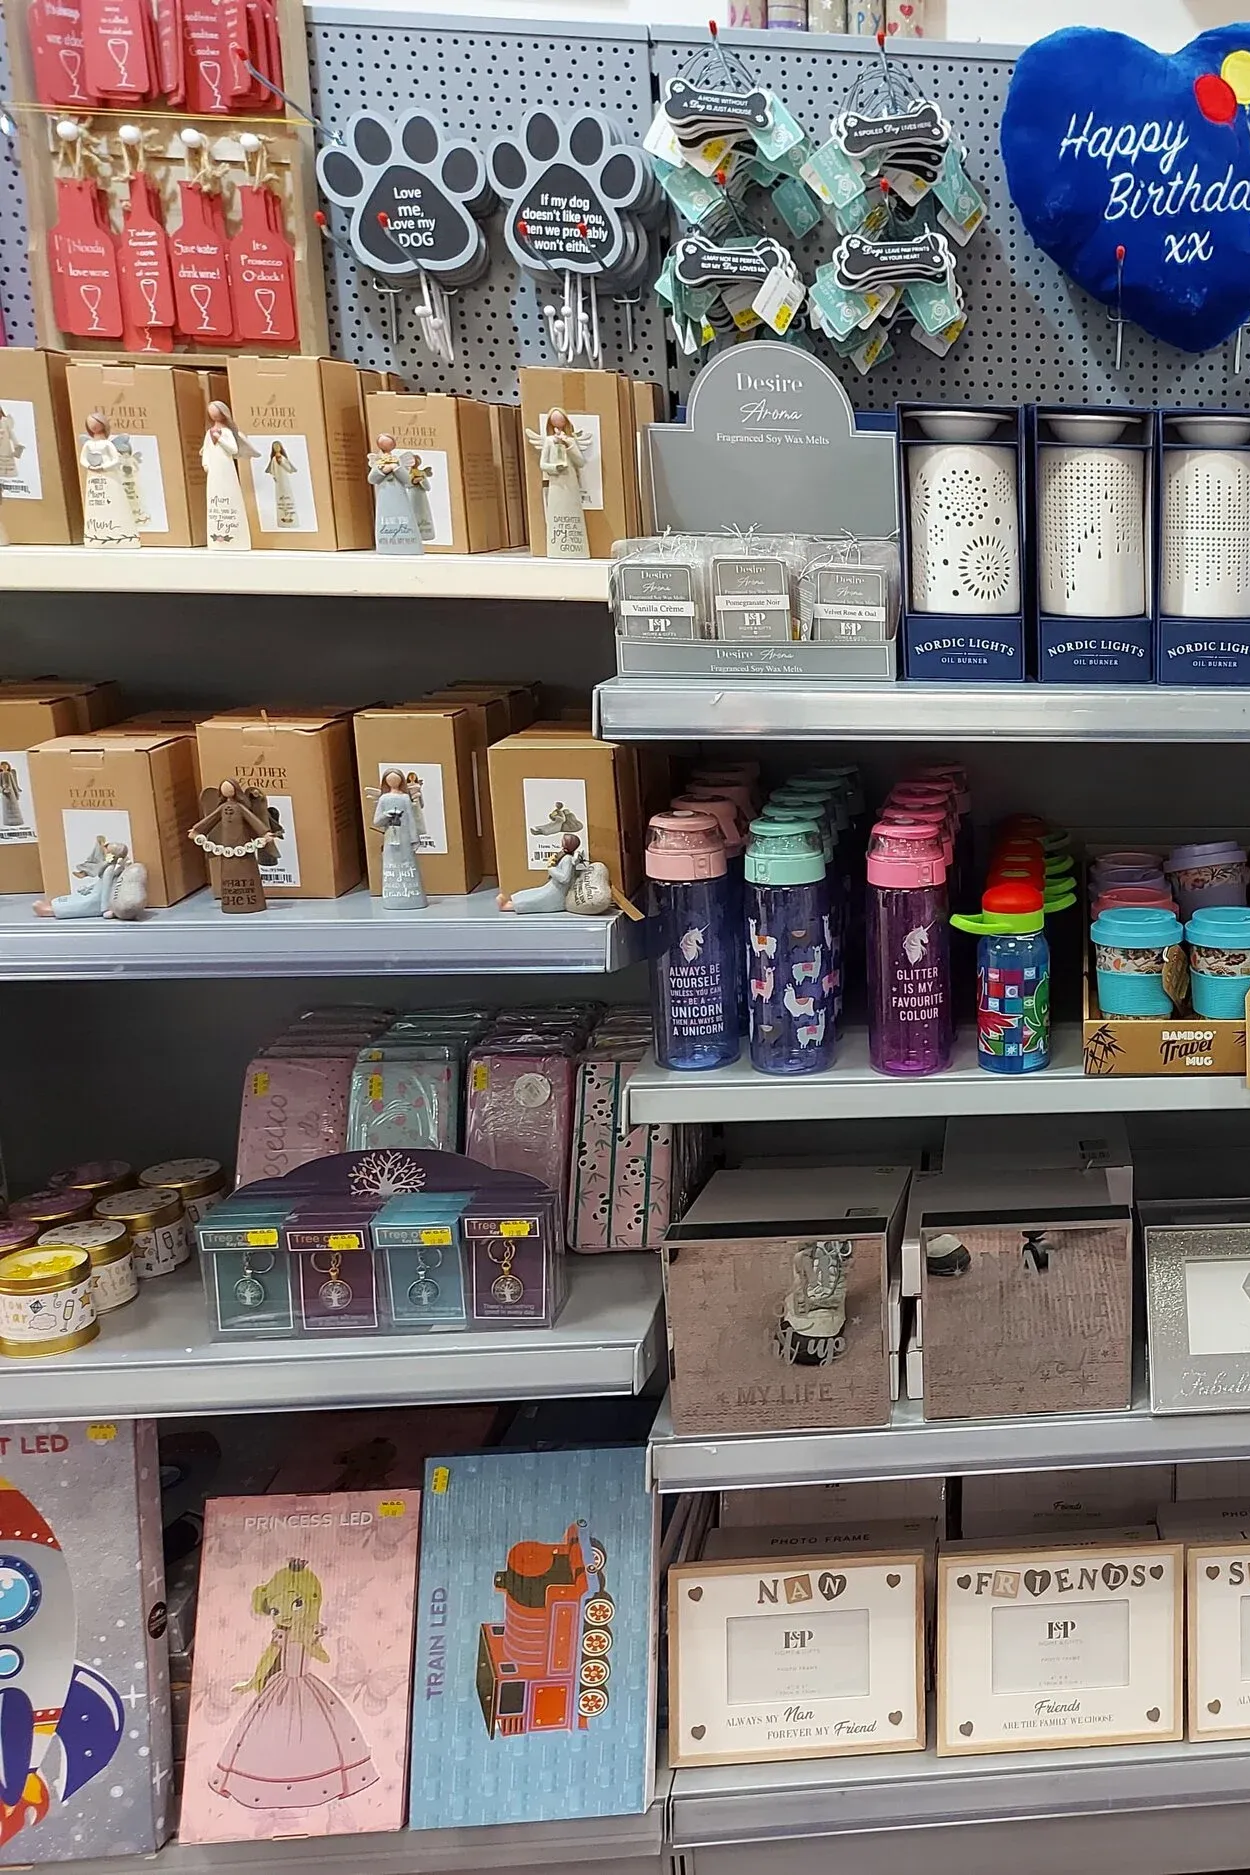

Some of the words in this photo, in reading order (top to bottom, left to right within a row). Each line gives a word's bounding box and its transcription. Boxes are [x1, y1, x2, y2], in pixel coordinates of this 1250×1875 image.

[858, 127, 884, 137] SPOILED
[884, 122, 901, 135] Dog
[1058, 110, 1190, 174] Happy
[393, 187, 422, 199] Love
[550, 196, 567, 210] my
[568, 194, 590, 211] dog
[397, 204, 424, 217] me,
[522, 207, 561, 222] doesn't
[562, 210, 581, 224] like
[582, 214, 605, 227] you,
[387, 217, 415, 230] Love
[417, 219, 436, 232] my
[398, 233, 434, 248] DOG
[533, 239, 564, 252] won't
[1164, 231, 1214, 263] xx
[240, 254, 283, 267] Prosecco
[735, 371, 804, 394] Desire
[249, 406, 296, 417] FEATHER
[739, 397, 804, 424] Aroma
[260, 418, 298, 429] GRACE
[391, 426, 437, 438] FEATHER
[716, 432, 764, 446] Fragranced
[765, 433, 782, 446] Soy
[784, 434, 803, 445] Wax
[805, 435, 831, 446] Melts
[641, 570, 672, 581] Desire
[632, 603, 658, 613] Vanilla
[659, 603, 685, 614] Crème
[716, 648, 754, 660] Desire
[913, 637, 966, 657] NORDIC
[968, 637, 1016, 657] LIGHTS
[1047, 639, 1098, 658] NORDIC
[1100, 639, 1146, 659] LIGHTS
[1166, 641, 1218, 660] NORDIC
[957, 656, 989, 665] BURNER
[1089, 658, 1120, 667] BURNER
[1207, 660, 1238, 668] BURNER
[710, 664, 749, 675] Fragranced
[235, 765, 287, 777] FEATHER
[69, 787, 116, 799] FEATHER
[669, 965, 707, 977] ALWAYS
[709, 963, 720, 974] BE
[896, 966, 939, 982] GLITTER
[669, 974, 721, 989] YOURSELF
[903, 983, 915, 994] IS
[917, 980, 934, 993] MY
[891, 992, 944, 1008] FAVOURITE
[671, 1002, 723, 1019] UNICORN
[899, 1007, 940, 1022] COLOUR
[681, 1022, 724, 1037] UNICORN
[1159, 1039, 1215, 1066] Travel
[1185, 1056, 1214, 1067] MUG
[205, 1233, 233, 1243] Tree
[293, 1234, 320, 1243] Tree
[381, 1230, 409, 1240] Tree
[737, 1386, 772, 1406] MY
[780, 1383, 834, 1403] LIFE
[20, 1434, 69, 1454] LED
[244, 1512, 333, 1531] PRINCESS
[339, 1511, 374, 1527] LED
[770, 1536, 818, 1546] PHOTO
[824, 1533, 871, 1543] FRAME
[757, 1571, 847, 1604] NAN
[974, 1562, 1147, 1600] FRIENDS
[433, 1586, 449, 1632] LED
[425, 1634, 449, 1700] TRAIN
[1034, 1699, 1081, 1716] Friends
[725, 1715, 763, 1728] ALWAYS
[764, 1714, 779, 1725] MY
[783, 1706, 815, 1723] Nan
[1021, 1719, 1038, 1730] THE
[1039, 1716, 1068, 1728] FAMILY
[1084, 1713, 1115, 1724] CHOOSE
[767, 1728, 813, 1740] FOREVER
[815, 1726, 830, 1737] MY
[833, 1719, 878, 1737] Friend
